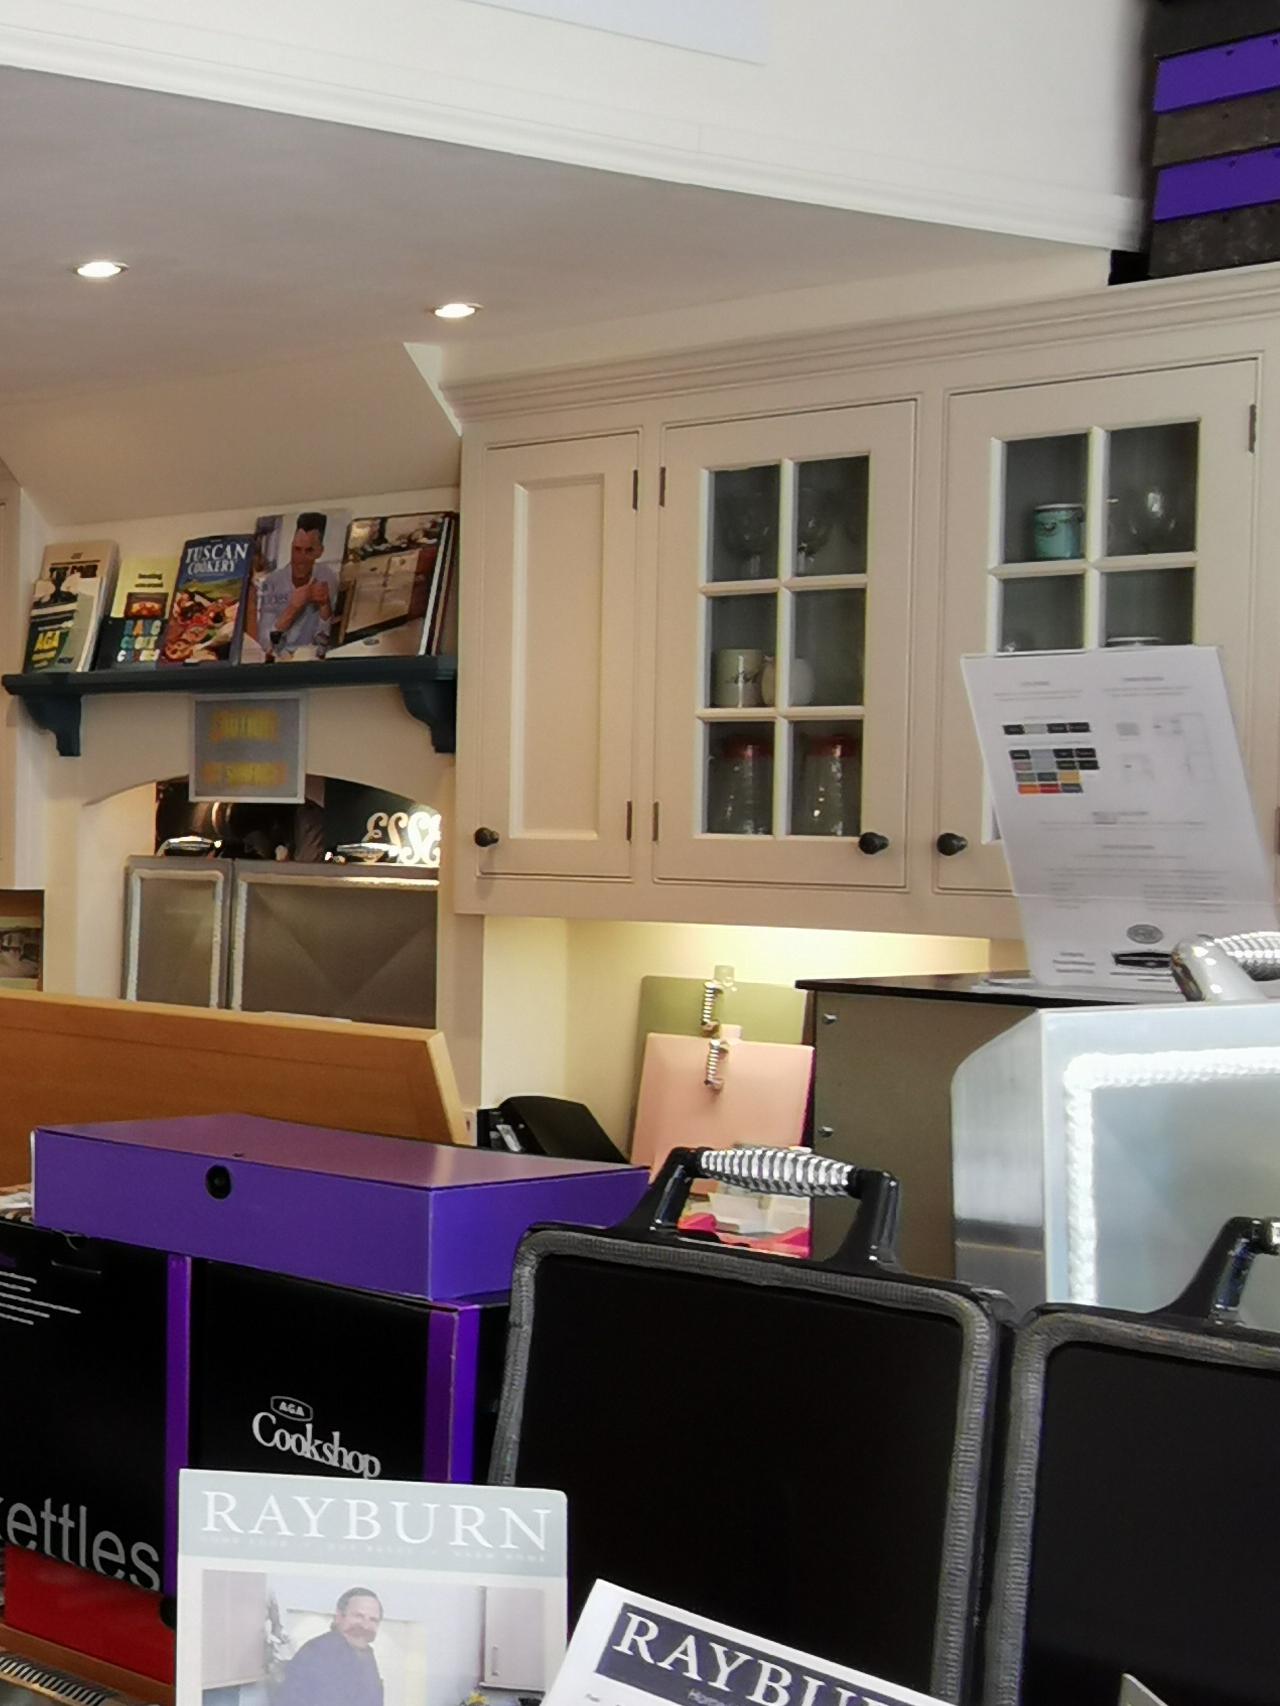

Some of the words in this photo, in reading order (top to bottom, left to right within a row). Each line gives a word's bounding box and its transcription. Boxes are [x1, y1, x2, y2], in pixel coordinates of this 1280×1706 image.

[184, 543, 249, 564] TUSCAN
[187, 560, 236, 575] COOKERY
[279, 1401, 305, 1417] AGA
[252, 1411, 381, 1480] Cookshop
[201, 1491, 552, 1552] RAYBURN
